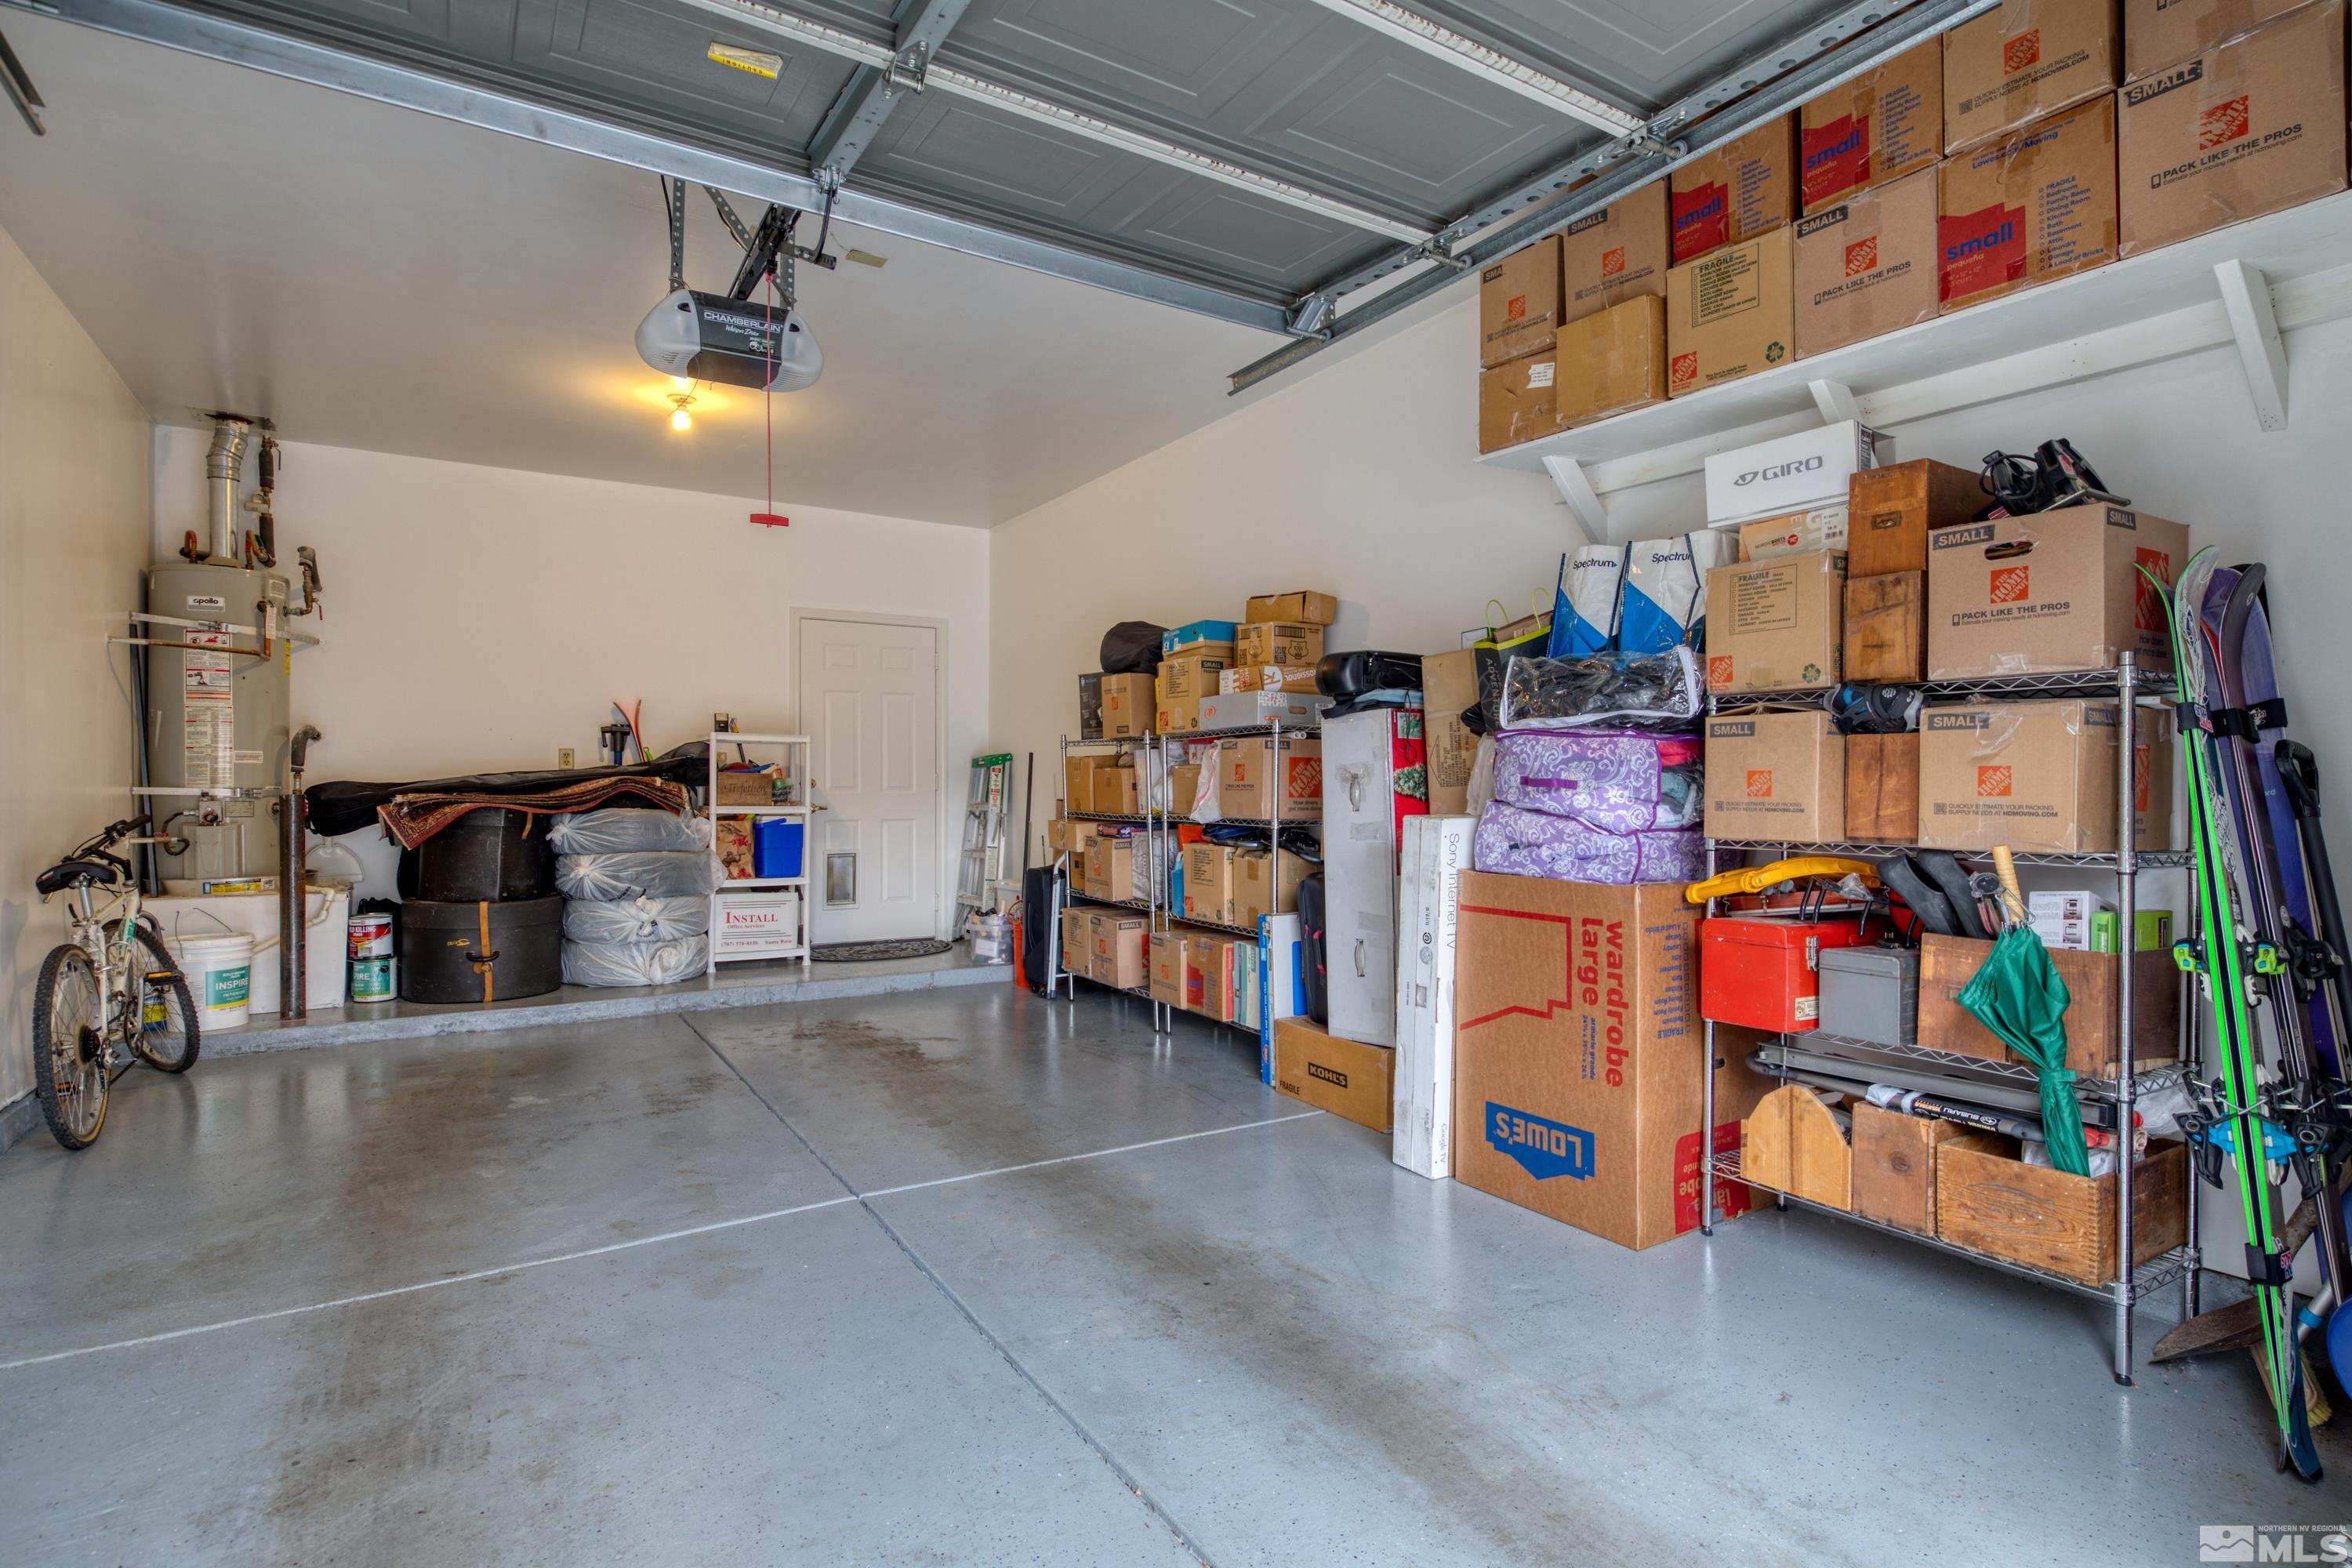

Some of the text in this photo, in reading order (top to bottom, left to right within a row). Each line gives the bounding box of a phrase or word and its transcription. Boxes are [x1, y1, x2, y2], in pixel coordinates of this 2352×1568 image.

[722, 59, 763, 74] CAUTION!
[1974, 49, 2085, 102] QUICKLY ESTIMATE YOUR PACKING
[1974, 95, 1998, 108] SUPPLY
[2000, 85, 2021, 98] NEEDS
[2031, 53, 2090, 83] HDMOVING.COM
[1806, 129, 1860, 170] small
[2163, 123, 2303, 180] PACK LIKE THE PROS
[2162, 172, 2188, 187] Estimate
[2189, 169, 2202, 180] your
[2203, 161, 2227, 176] moving
[2253, 133, 2303, 155] hdmoving.com
[2045, 176, 2076, 191] FRAGILE
[2045, 184, 2078, 198] Bedroom
[2045, 187, 2092, 207] Family Room
[2045, 195, 2092, 216] Dining Room
[1676, 196, 1722, 229] small
[1802, 209, 1844, 234] SMALL
[2046, 209, 2074, 222] Kitchen
[1570, 212, 1605, 234] SMALL
[2046, 220, 2063, 230] Bath
[2046, 222, 2083, 238] Basement
[1947, 220, 2013, 262] small
[2046, 235, 2065, 245] Attic
[2046, 240, 2077, 255] Laundry
[1699, 254, 1734, 274] FRAGILE
[1947, 253, 1984, 271] pequeña
[2047, 249, 2074, 261] Garage
[2053, 256, 2073, 267] Load
[2073, 252, 2081, 262] of
[2081, 247, 2104, 260] Bricks
[1822, 261, 1911, 298] PACK LIKE THE PROS
[703, 311, 781, 332] CHAMBERLAIN
[1762, 456, 1824, 481] GIRO
[2109, 510, 2134, 527] SMALL
[1937, 528, 1989, 547] SMALL
[1573, 557, 1614, 572] Spectrum
[1652, 552, 1691, 565] Spectru
[1738, 572, 1769, 583] FRAGILE
[1991, 565, 2029, 603] HOME
[1962, 601, 2071, 622] PACK LIKE THE PROS
[1933, 714, 1984, 728] SMALL
[2089, 710, 2114, 724] SMALL
[1714, 724, 1751, 736] SMALL
[1289, 758, 1322, 797] HOME
[1978, 766, 2012, 797] HOME
[1446, 833, 1460, 949] Sony Internet TV
[725, 911, 778, 924] INSTALL
[1577, 916, 1603, 1007] large
[216, 977, 249, 991] INSPIRE
[354, 972, 370, 981] PIRE
[1606, 920, 1629, 1088] wardrobe
[1656, 1025, 1684, 1040] FRAGILE
[1309, 1064, 1347, 1087] KOHL'S
[1279, 1080, 1301, 1096] FRAGILE
[1915, 1101, 1980, 1120] SUBARU YAKIMA
[1439, 1123, 1448, 1163] Google TV
[1495, 1112, 1582, 1168] LOWE'S
